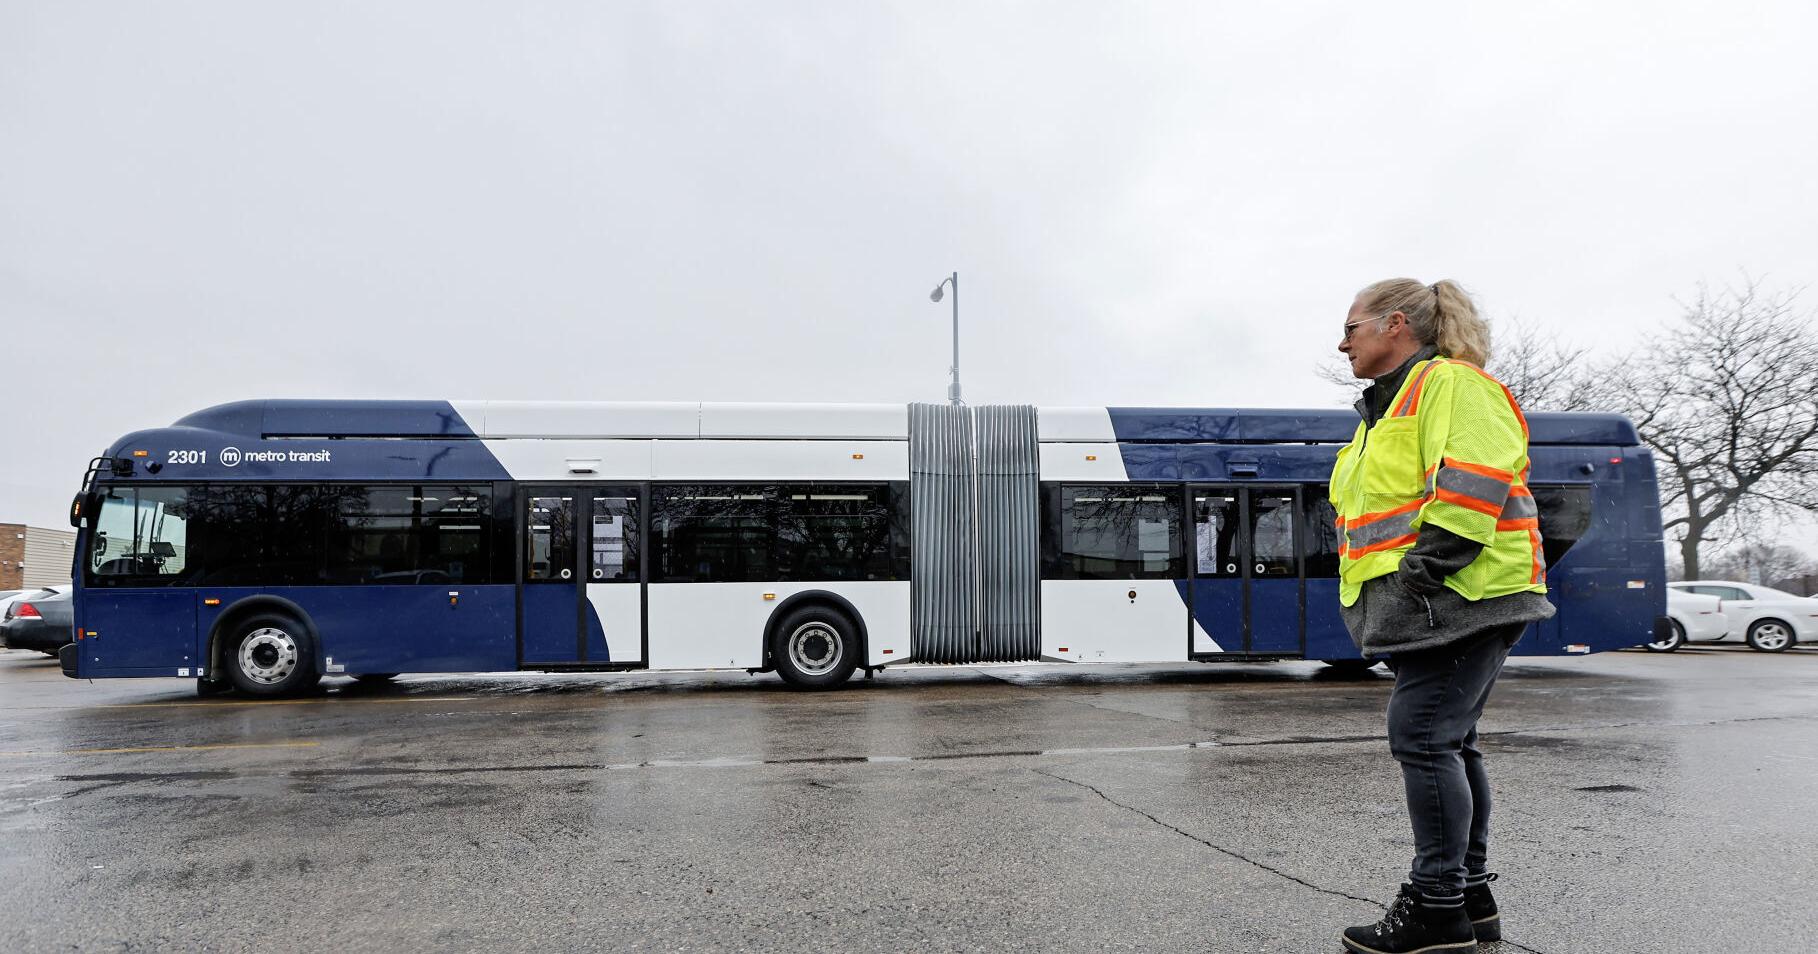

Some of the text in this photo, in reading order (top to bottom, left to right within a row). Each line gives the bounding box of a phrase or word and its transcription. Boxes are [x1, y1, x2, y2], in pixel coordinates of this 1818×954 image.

[168, 450, 206, 464] 2301
[245, 450, 286, 462] metro
[289, 449, 331, 462] transit
